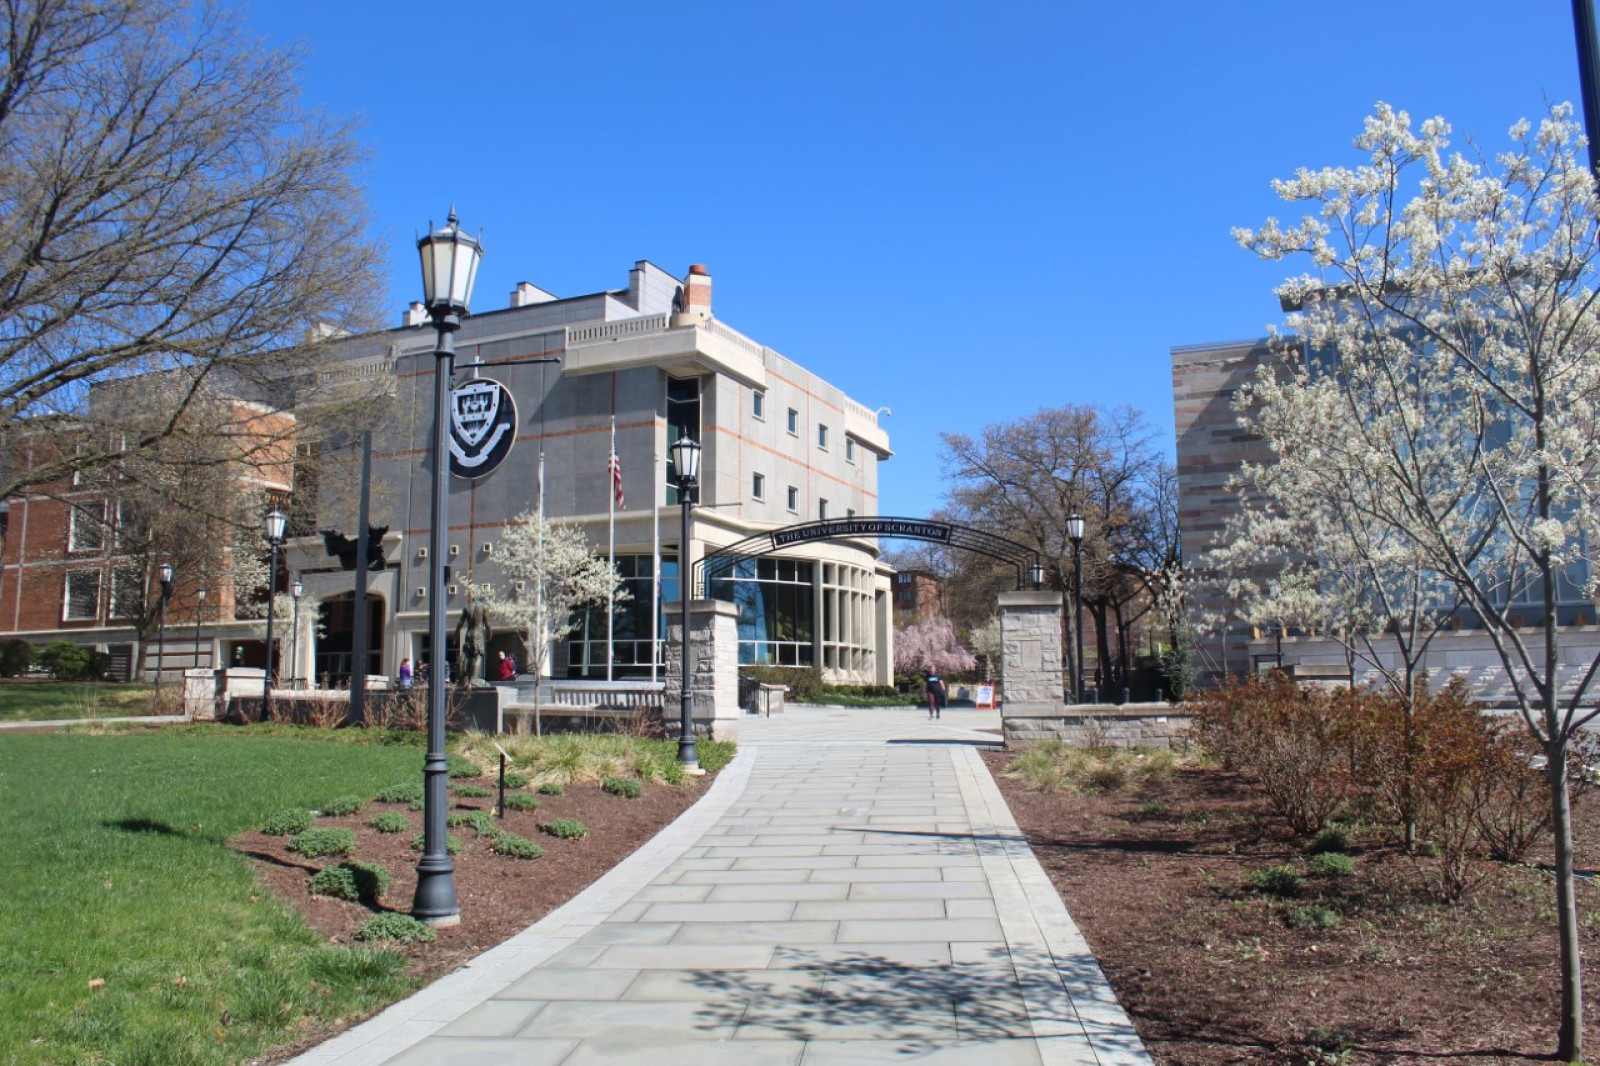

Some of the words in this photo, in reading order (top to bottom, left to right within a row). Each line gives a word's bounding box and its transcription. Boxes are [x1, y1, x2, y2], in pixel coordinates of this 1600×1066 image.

[780, 533, 801, 543] THE
[803, 524, 866, 537] UNIVERSITY
[868, 523, 881, 531] OF
[884, 524, 942, 537] SCRANTON
